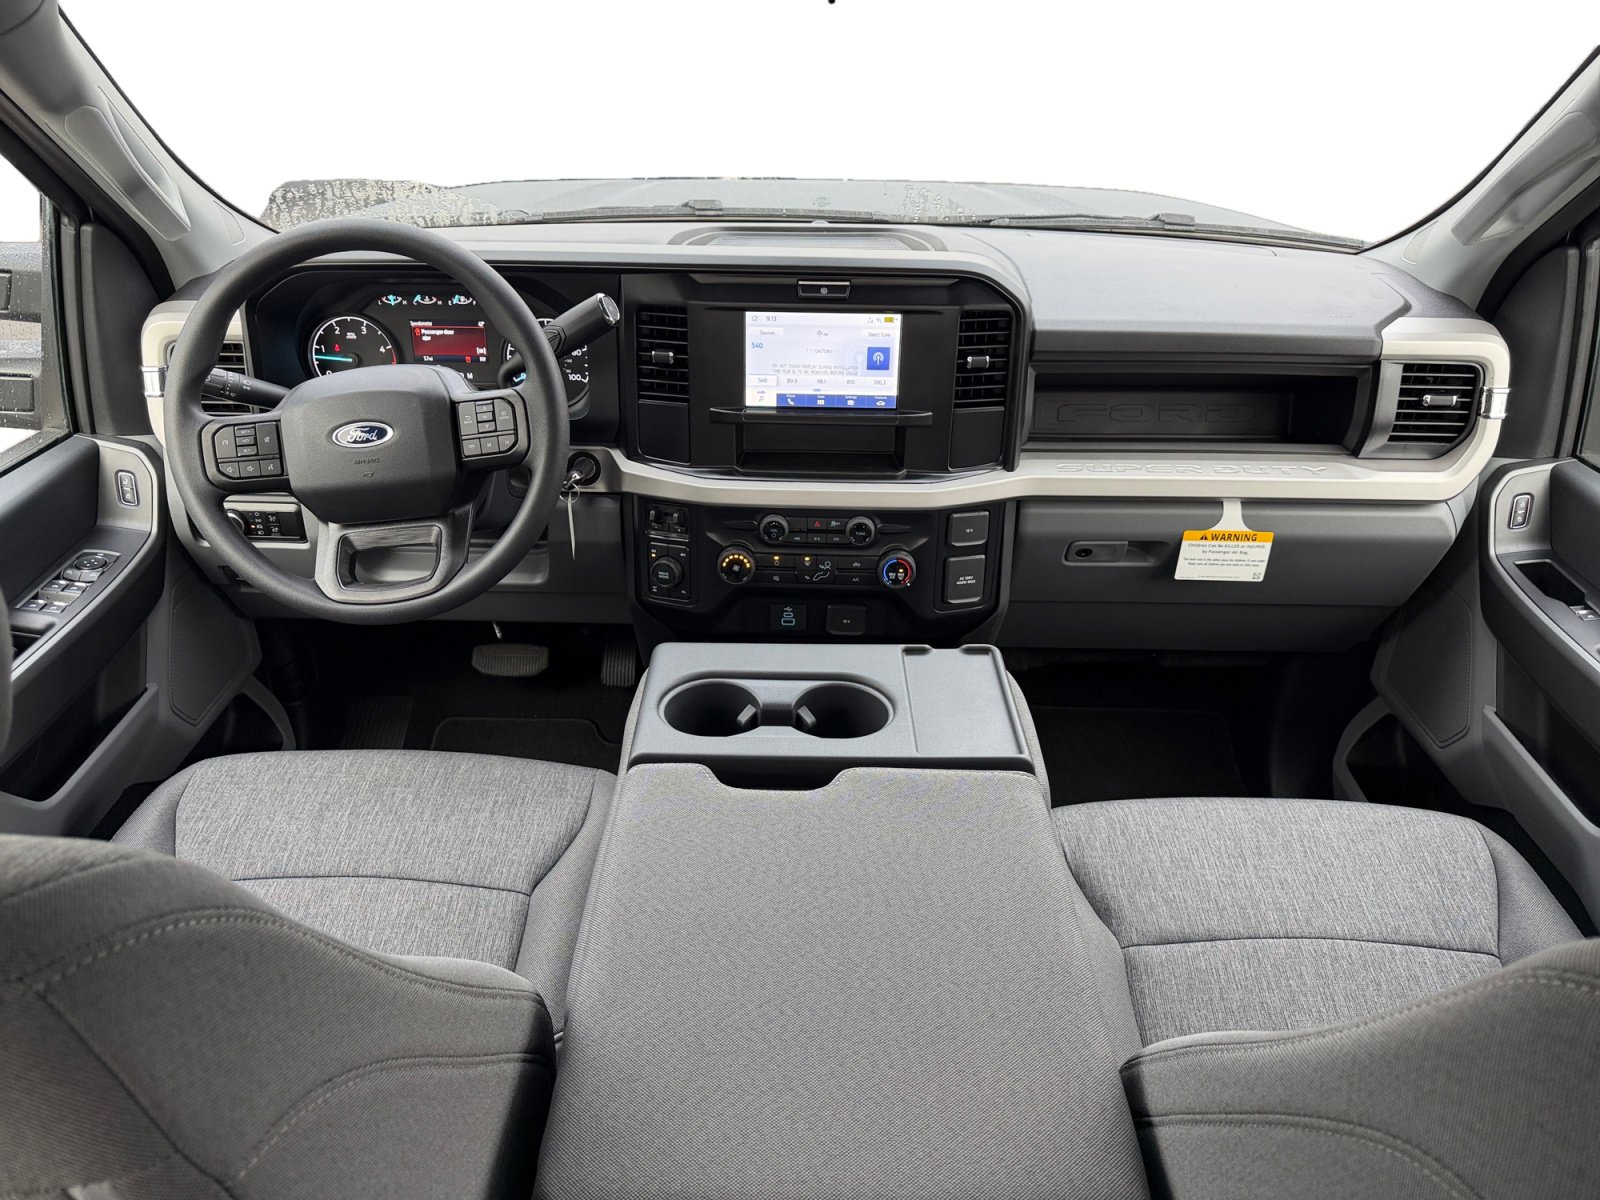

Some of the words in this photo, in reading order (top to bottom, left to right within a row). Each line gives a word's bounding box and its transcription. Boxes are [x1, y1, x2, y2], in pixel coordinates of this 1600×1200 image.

[334, 326, 341, 334] 2
[361, 326, 367, 334] 3
[320, 345, 326, 353] 1
[379, 345, 387, 353] 4
[1056, 403, 1256, 423] FORD
[347, 427, 377, 443] Ford
[1056, 463, 1204, 474] SUPER
[1210, 463, 1327, 476] DUTY
[1211, 533, 1257, 542] WARNING
